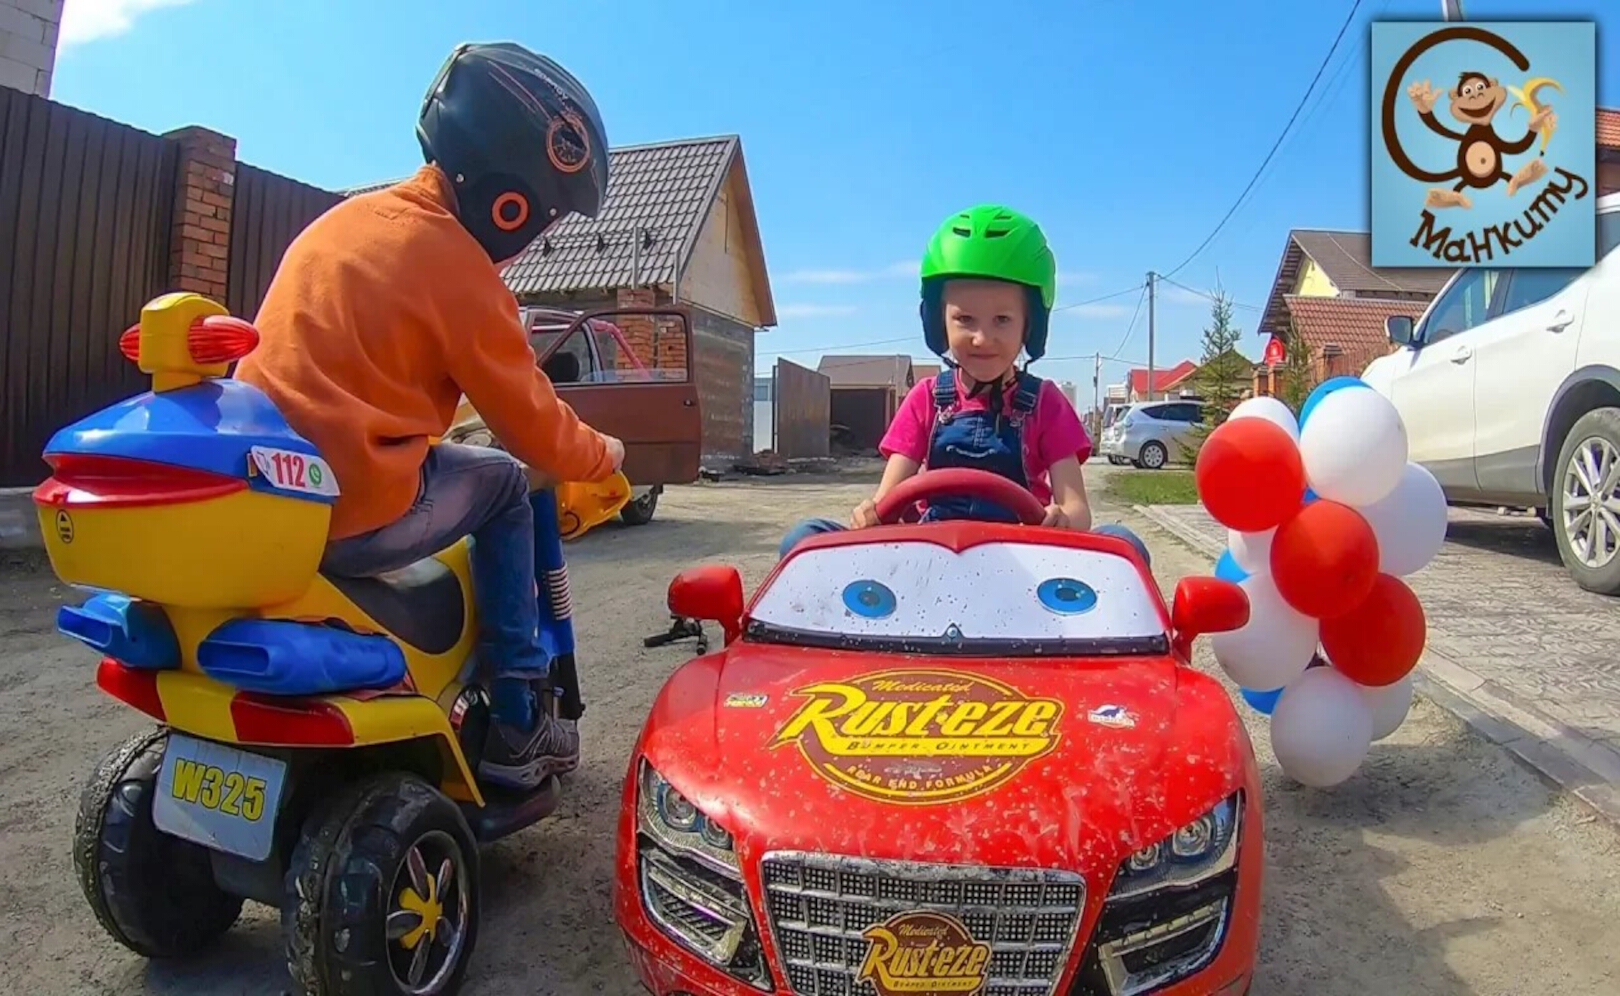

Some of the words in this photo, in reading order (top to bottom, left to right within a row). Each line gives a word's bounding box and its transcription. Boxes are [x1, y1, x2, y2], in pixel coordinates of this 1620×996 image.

[271, 452, 306, 488] 112
[871, 680, 975, 693] Medicated
[846, 741, 921, 751] BUMPER
[935, 741, 1031, 751] OINTMENT
[172, 757, 267, 822] W325
[887, 778, 918, 790] END
[926, 765, 993, 789] FORMULA
